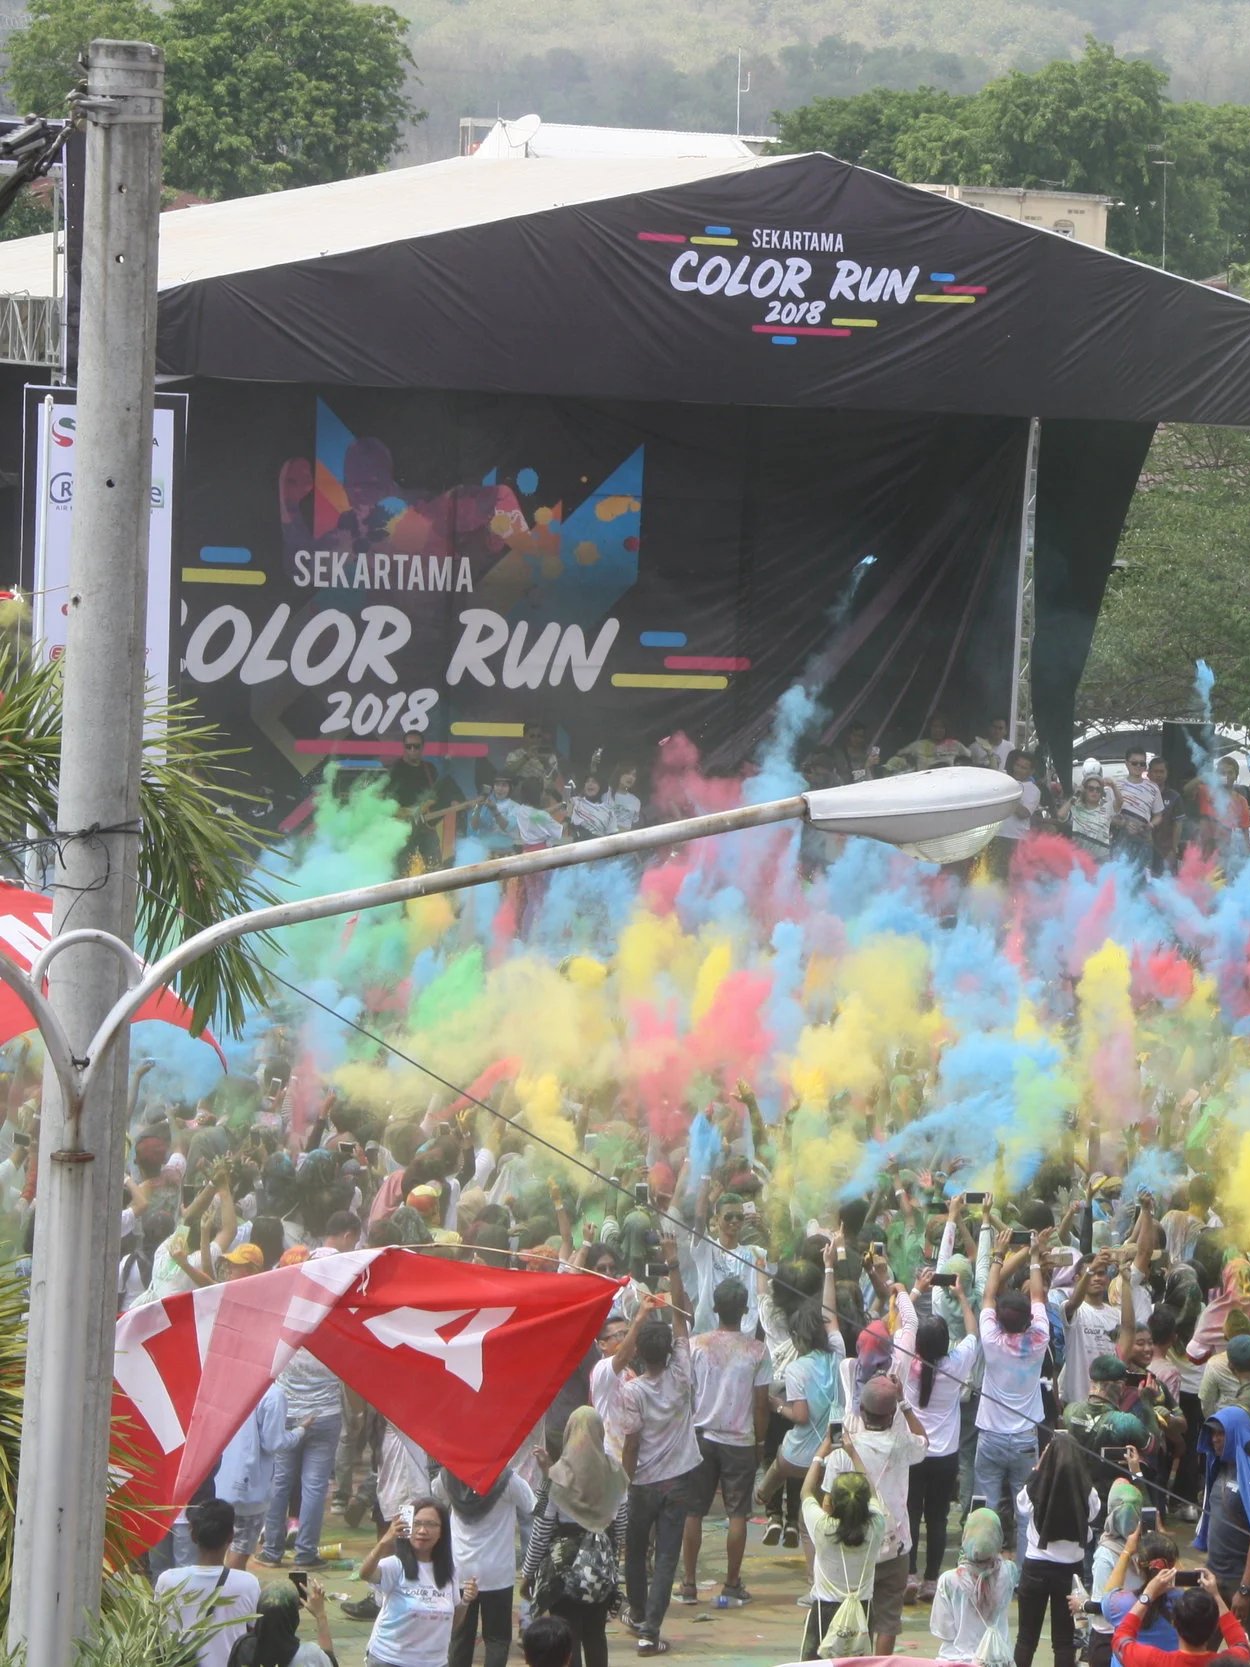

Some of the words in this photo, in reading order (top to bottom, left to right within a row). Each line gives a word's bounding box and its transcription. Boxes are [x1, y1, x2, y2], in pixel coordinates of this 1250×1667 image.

[751, 228, 844, 253] SEKARTAMA
[669, 250, 812, 299] COLOR
[829, 259, 920, 305] RUN
[764, 300, 826, 325] 2018
[293, 550, 474, 593] SEKARTAMA
[180, 598, 412, 687] OLOR
[445, 607, 620, 692] RUN
[319, 687, 440, 736] 2018
